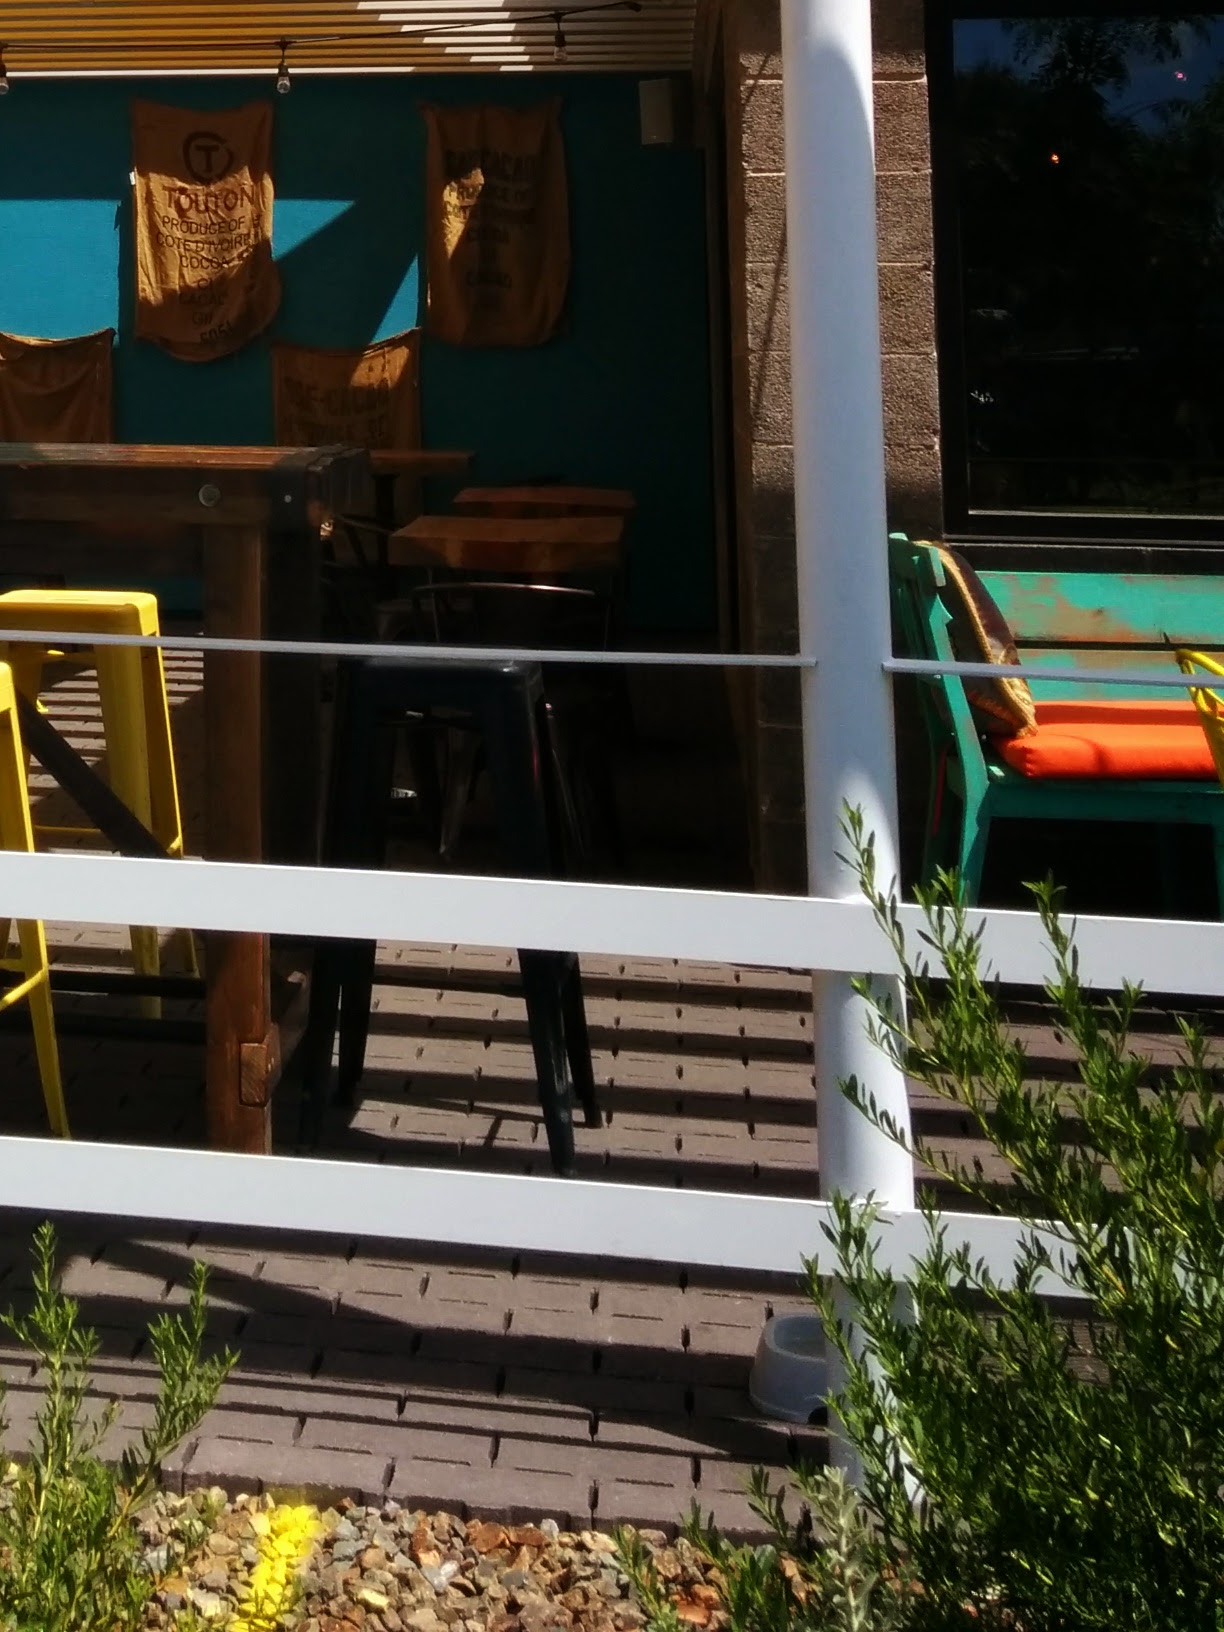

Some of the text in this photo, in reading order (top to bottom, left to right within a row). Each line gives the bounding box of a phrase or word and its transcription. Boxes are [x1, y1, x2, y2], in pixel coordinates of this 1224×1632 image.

[161, 185, 255, 214] TOUTON
[162, 215, 246, 235] PRODUCE OF
[156, 232, 191, 252] COTE
[180, 254, 231, 269] COCOA
